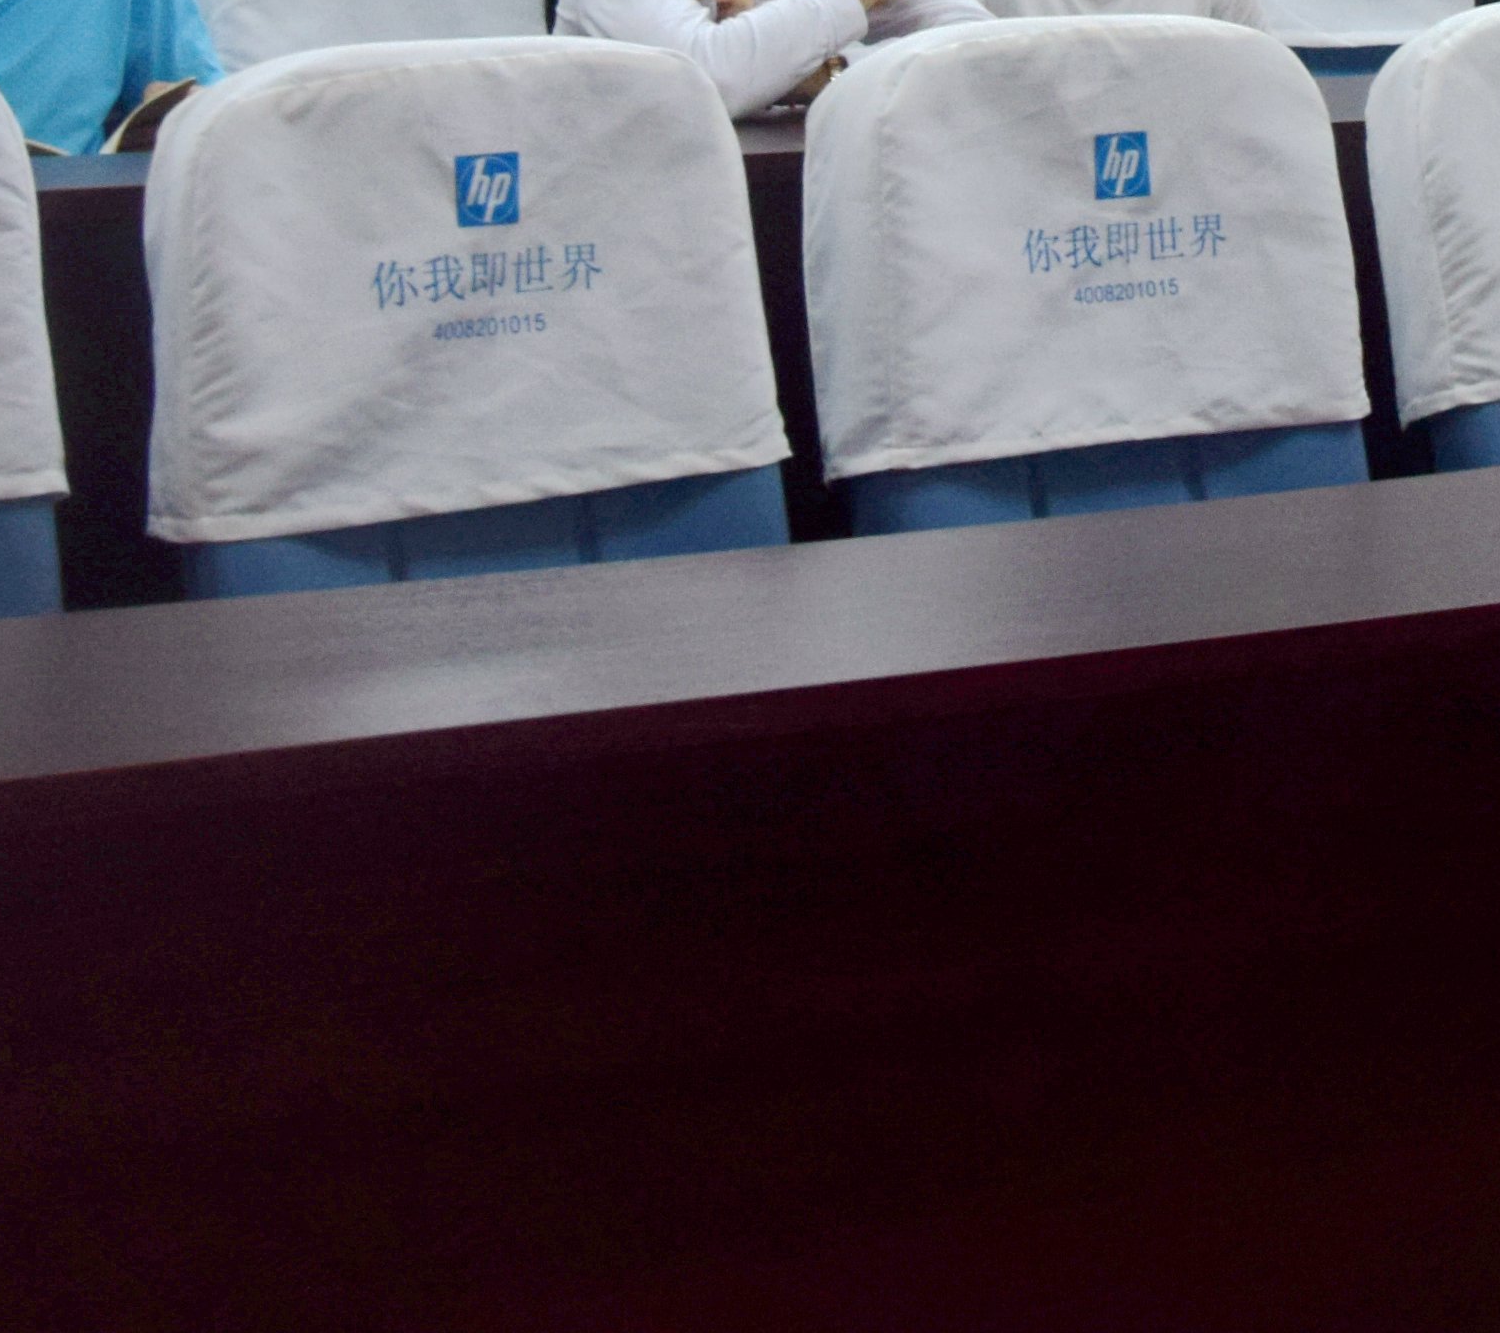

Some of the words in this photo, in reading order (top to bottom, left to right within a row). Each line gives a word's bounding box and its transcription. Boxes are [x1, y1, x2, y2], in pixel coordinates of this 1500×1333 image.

[465, 154, 510, 224] hp
[1102, 132, 1141, 197] hp
[1024, 213, 1225, 274] 你我即世界
[372, 244, 603, 310] 你我即世界
[1074, 278, 1178, 304] 4008201015
[434, 313, 546, 341] 4008201015
